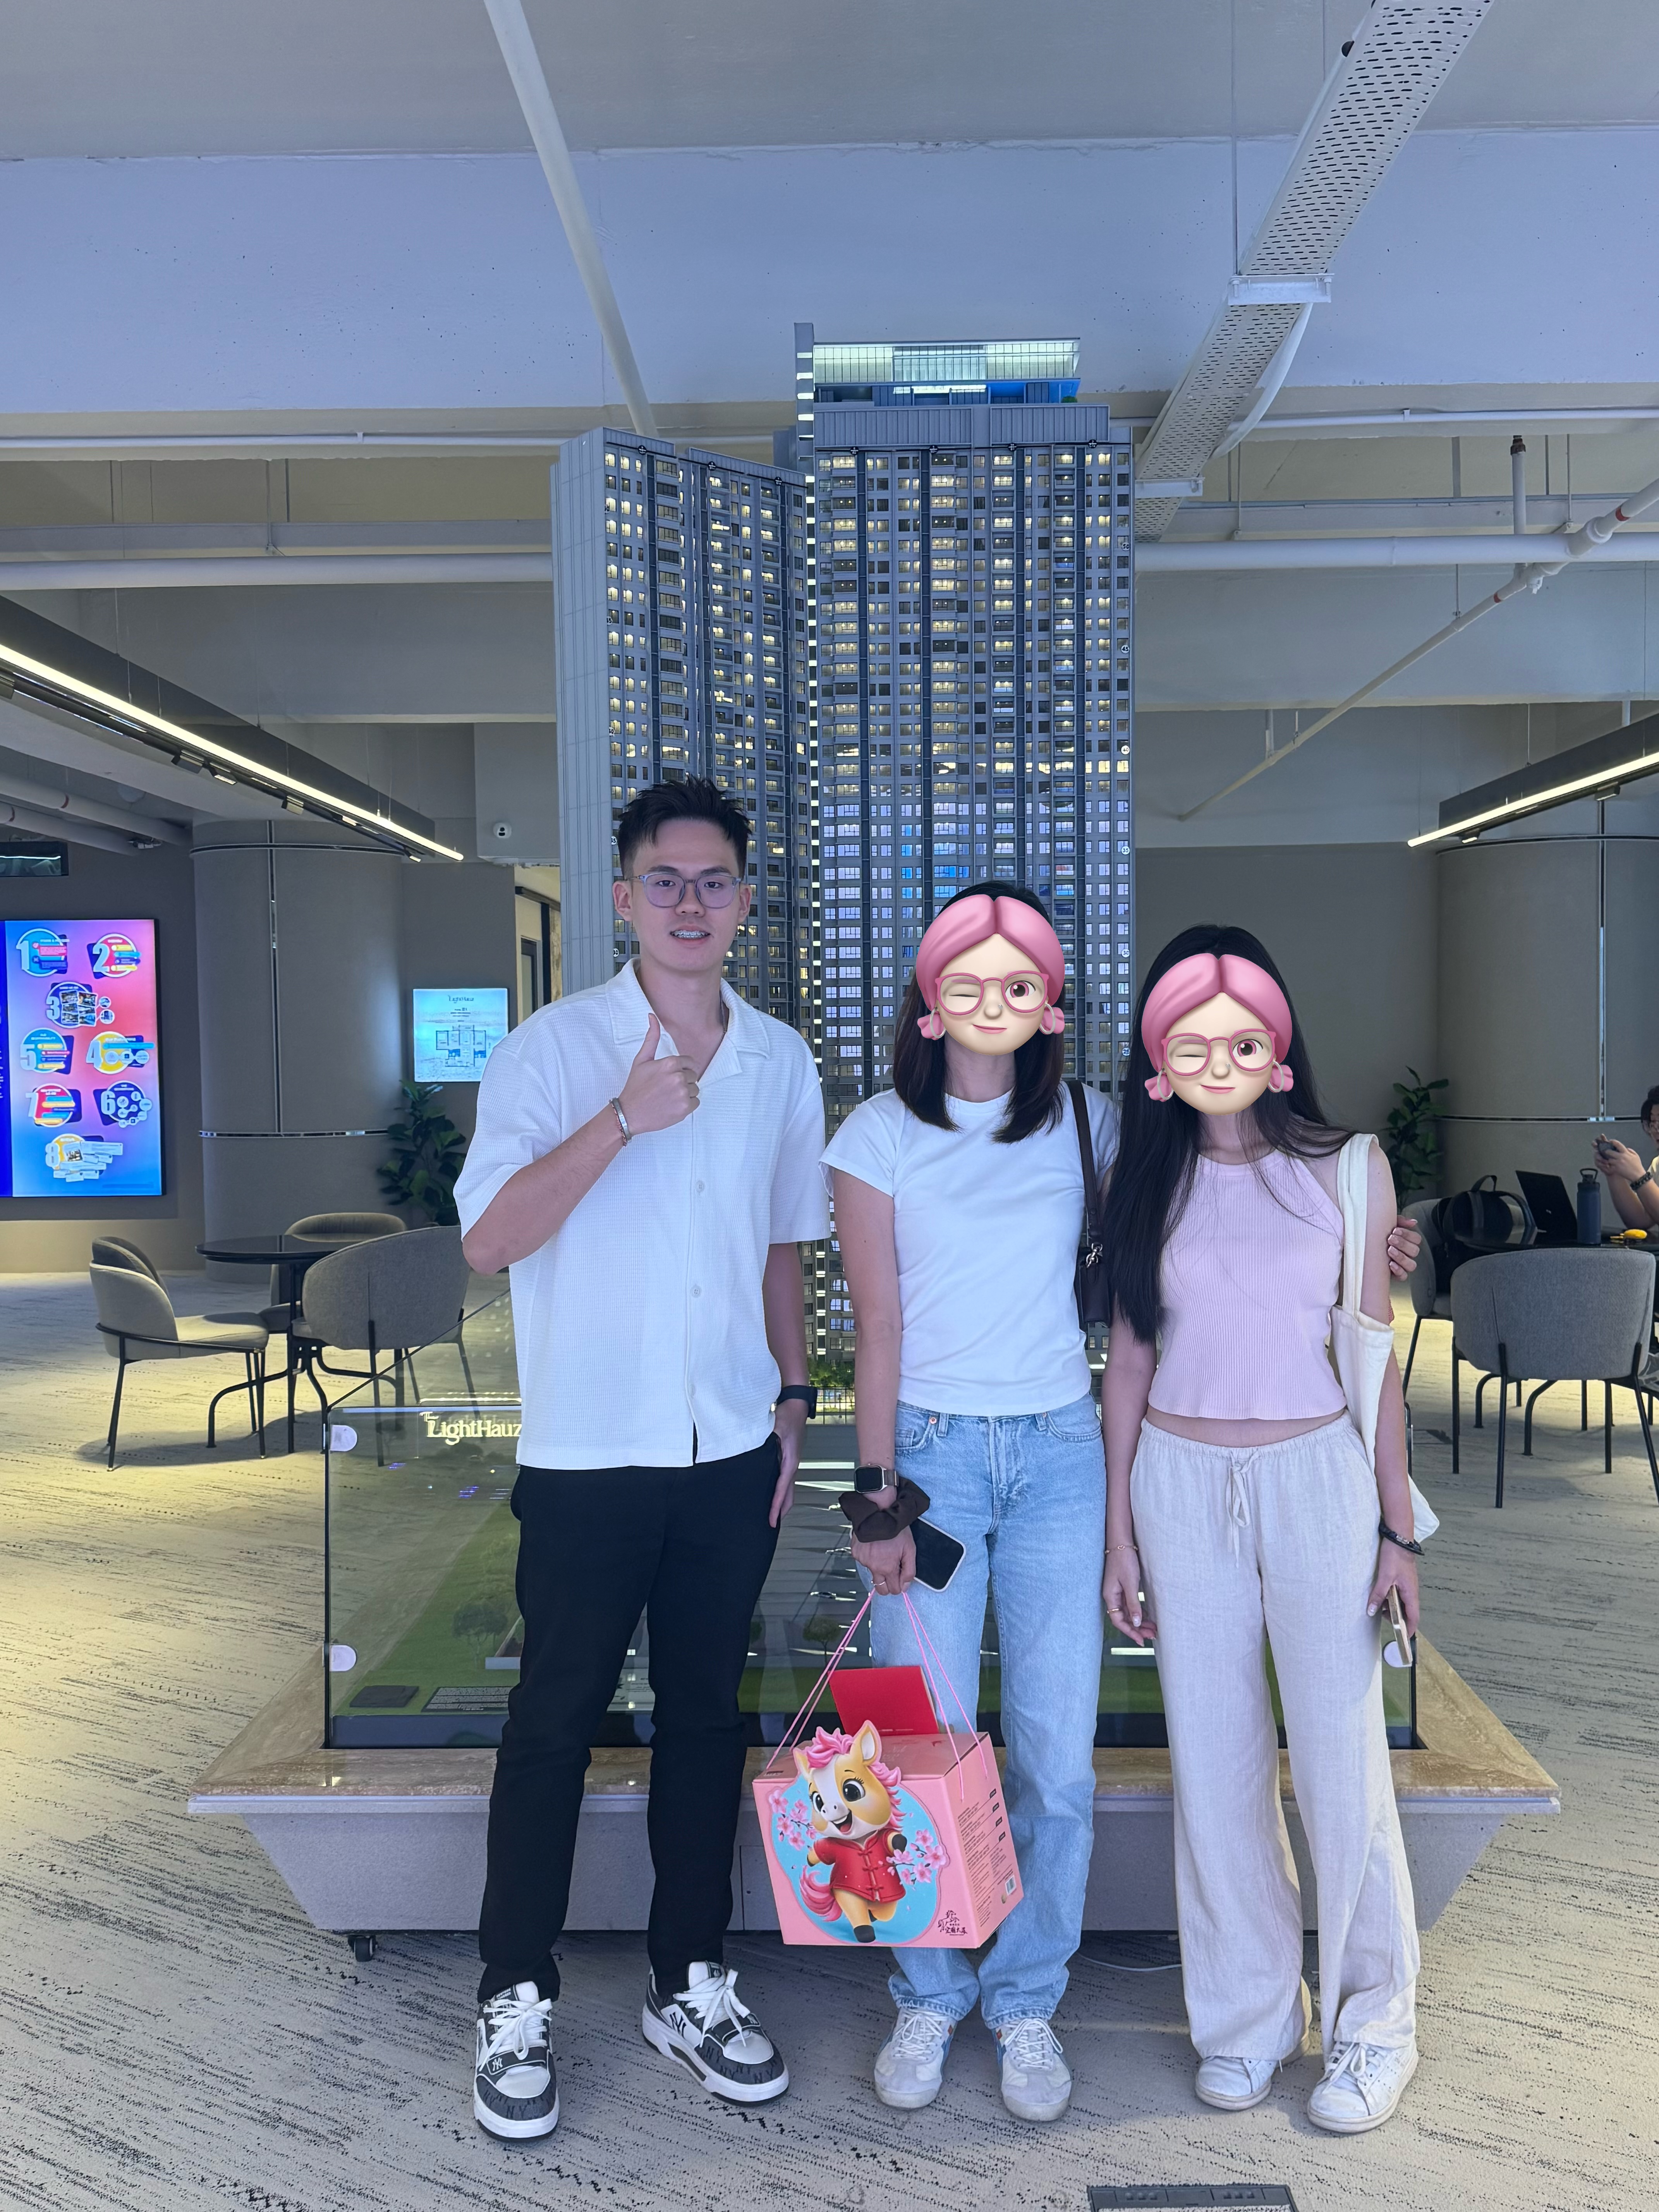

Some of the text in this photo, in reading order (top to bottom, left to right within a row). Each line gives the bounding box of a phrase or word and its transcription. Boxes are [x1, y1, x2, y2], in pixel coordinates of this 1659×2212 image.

[16, 940, 29, 970] 1
[93, 943, 110, 972] 2
[46, 996, 60, 1020] 3
[20, 1044, 36, 1070] 5
[86, 1041, 102, 1068] 4
[26, 1092, 38, 1118] 7
[101, 1091, 115, 1115] 6
[45, 1143, 60, 1167] 8
[427, 1420, 522, 1445] LightHauz
[492, 2057, 503, 2071] NY
